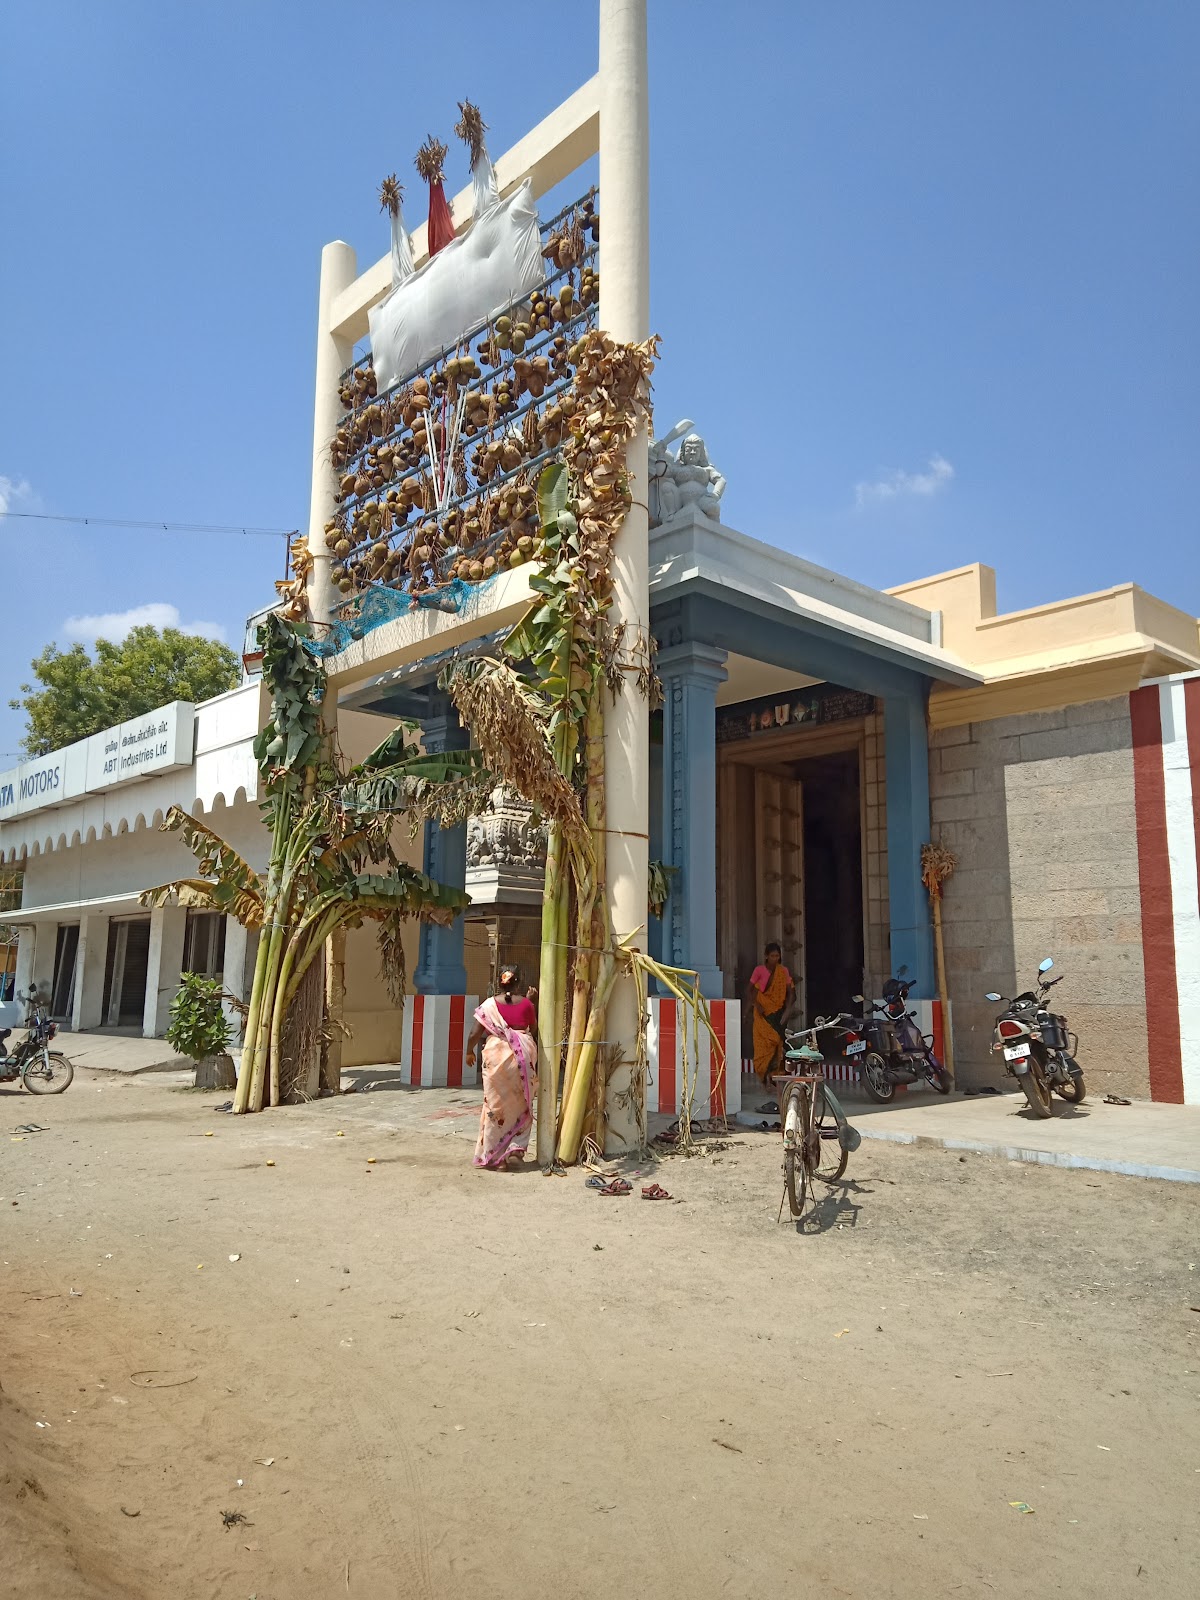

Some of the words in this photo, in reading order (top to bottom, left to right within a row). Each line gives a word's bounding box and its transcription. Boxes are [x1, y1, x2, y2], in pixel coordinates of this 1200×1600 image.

[103, 757, 118, 774] ABT
[120, 748, 154, 770] Industries
[155, 740, 168, 758] Ltd
[0, 783, 14, 808] TA
[20, 766, 60, 801] MOTORS
